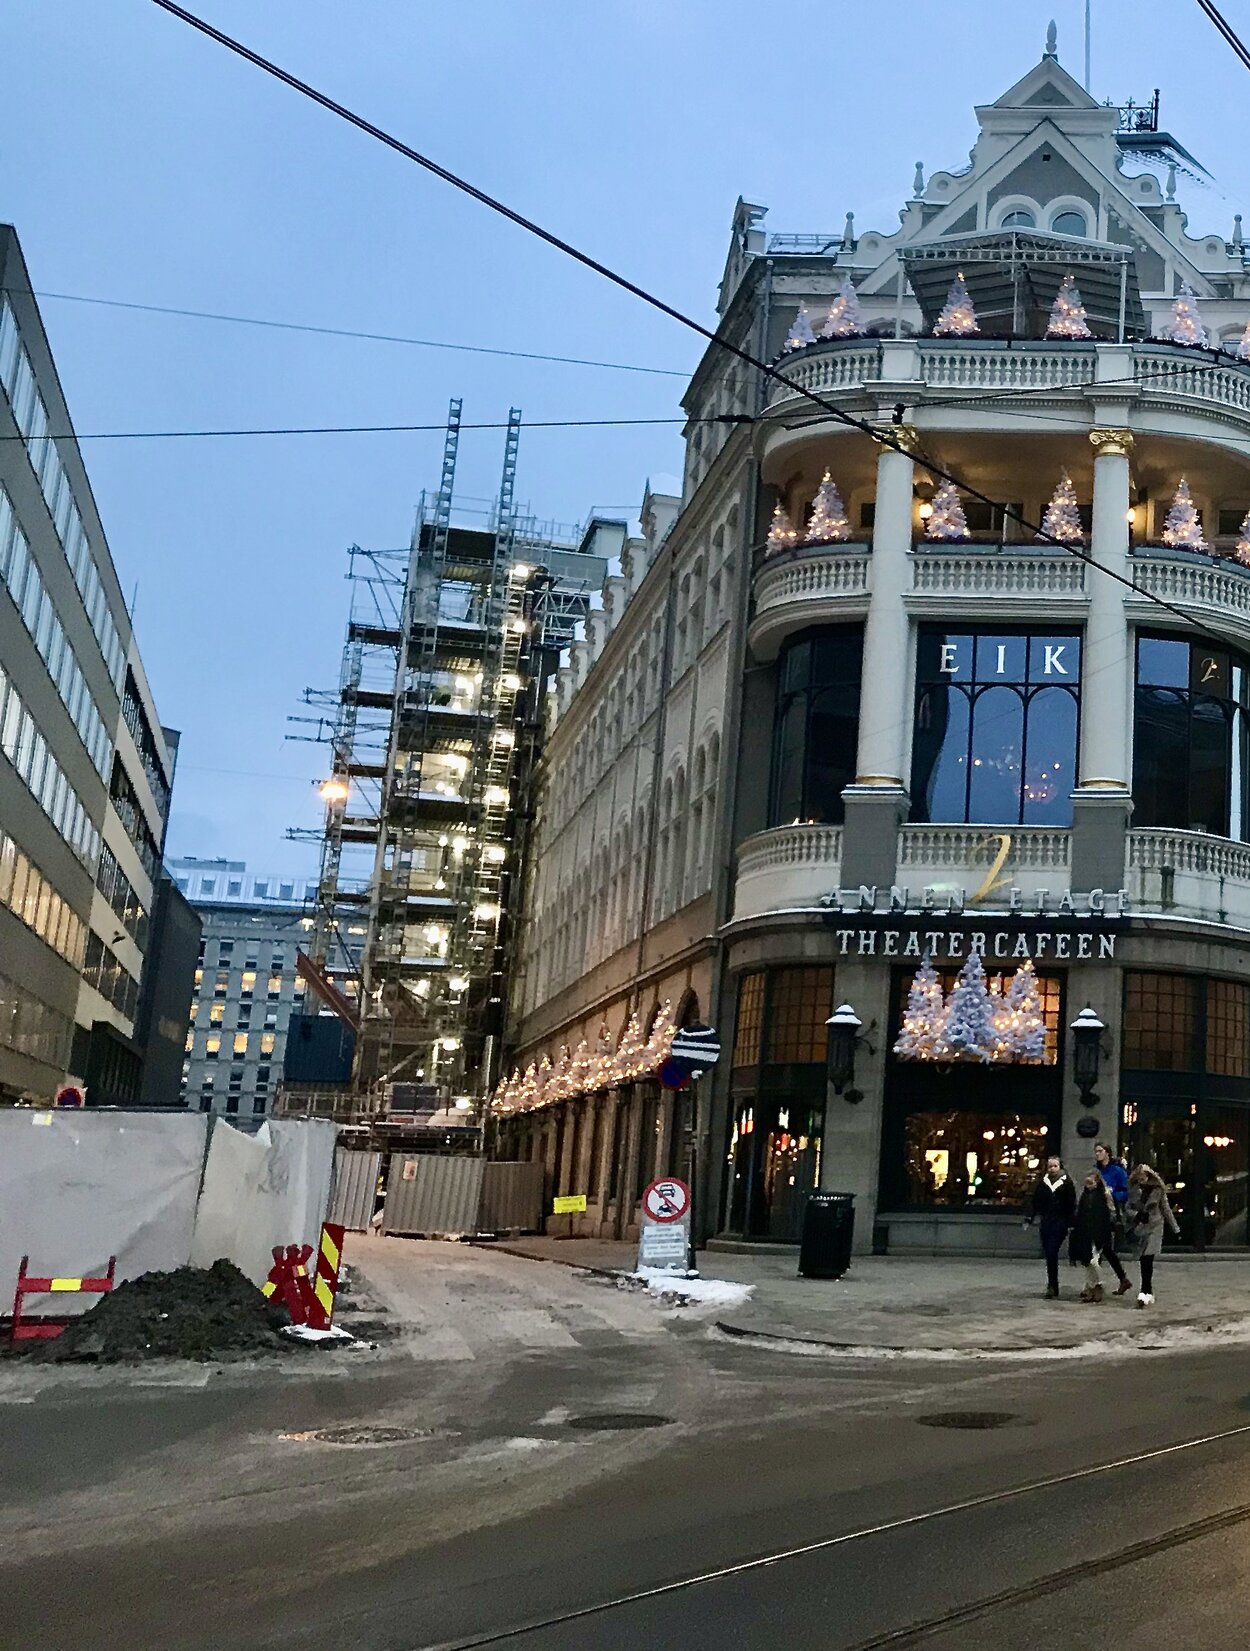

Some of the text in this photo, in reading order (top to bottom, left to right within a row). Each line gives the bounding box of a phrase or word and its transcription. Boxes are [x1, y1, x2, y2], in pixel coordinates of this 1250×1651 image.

[939, 644, 1068, 675] EIK
[819, 885, 966, 908] ANNEN
[1009, 887, 1130, 910] ETAGE
[836, 929, 1116, 959] THEATERCAFEEN
